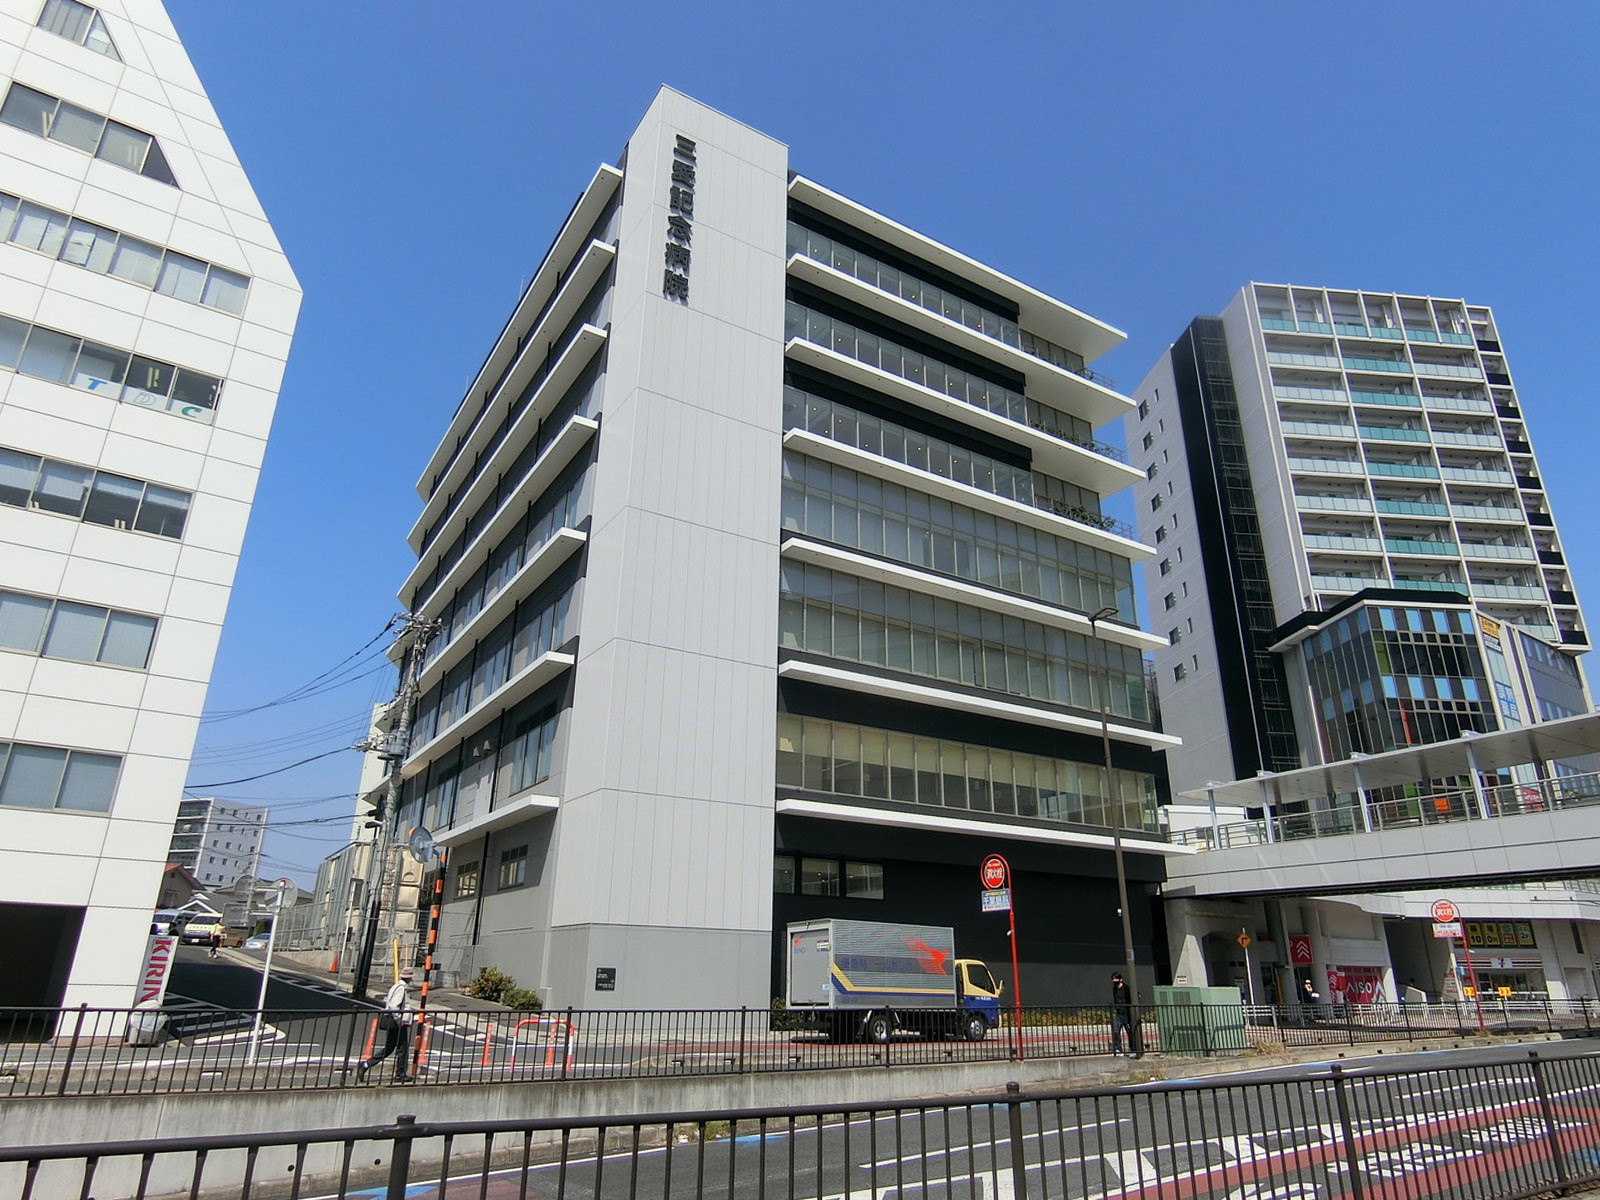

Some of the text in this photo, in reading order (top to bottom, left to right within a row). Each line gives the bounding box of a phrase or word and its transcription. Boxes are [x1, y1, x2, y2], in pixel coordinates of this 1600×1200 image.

[663, 133, 697, 302] 三愛記念病院
[140, 939, 173, 1003] KIRIN
[1345, 981, 1373, 994] AISO
